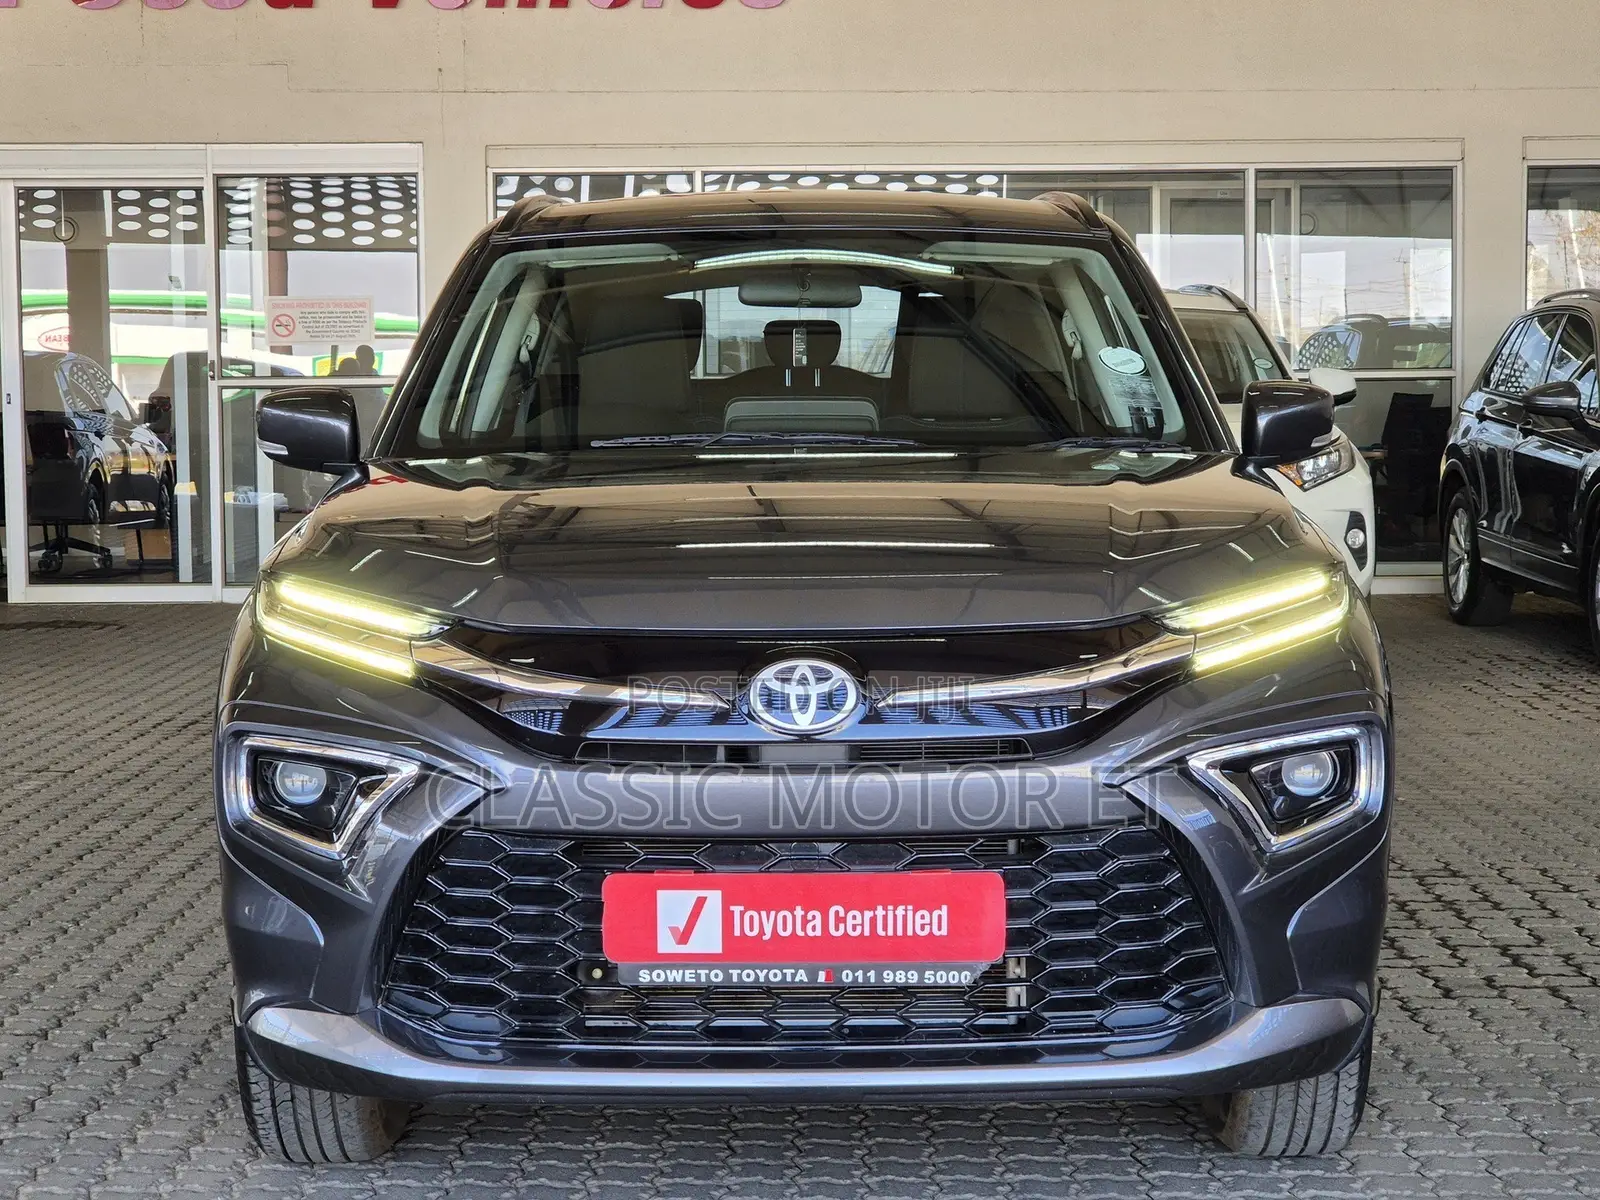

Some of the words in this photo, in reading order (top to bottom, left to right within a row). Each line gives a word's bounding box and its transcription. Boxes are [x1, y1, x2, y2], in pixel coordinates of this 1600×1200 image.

[729, 904, 822, 940] Toyota
[828, 904, 949, 937] Certified
[638, 968, 724, 983] SOWETO
[728, 968, 809, 983] TOYOTA
[841, 969, 876, 984] 011
[882, 969, 919, 984] 989
[923, 970, 972, 985] 5000
